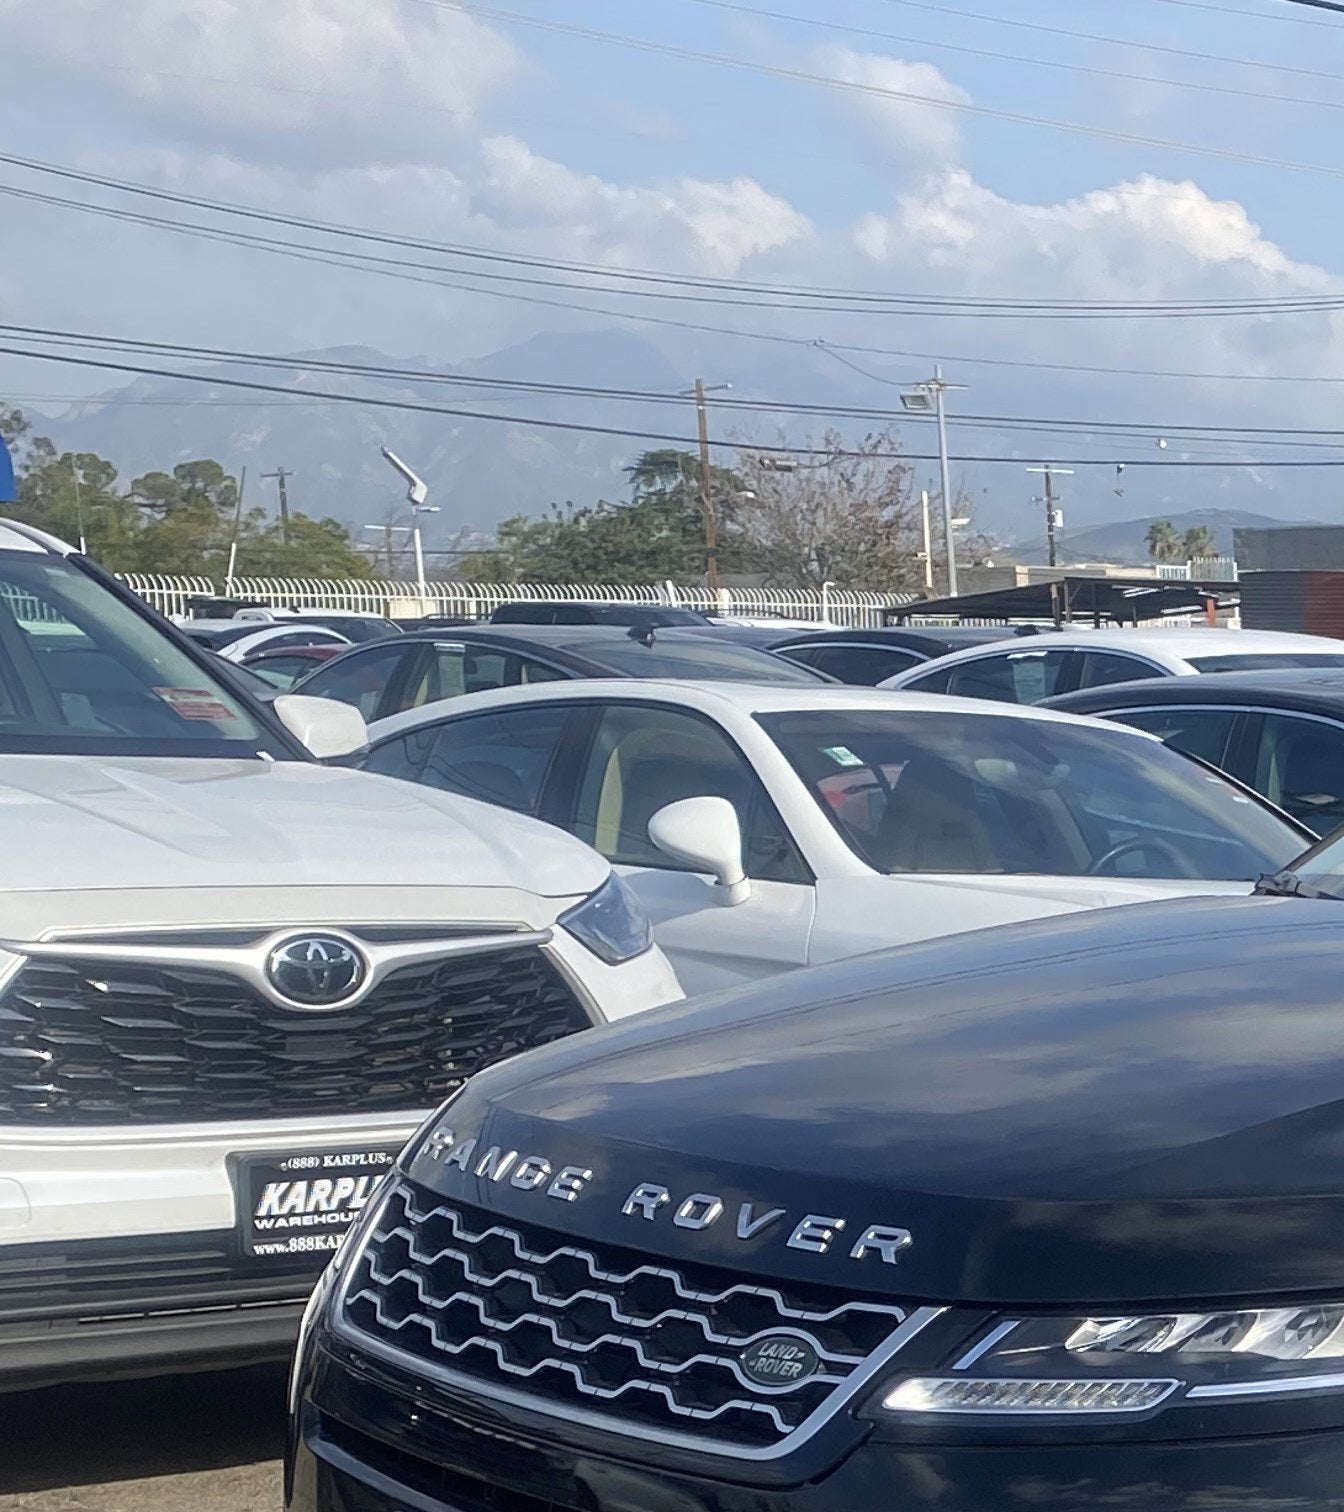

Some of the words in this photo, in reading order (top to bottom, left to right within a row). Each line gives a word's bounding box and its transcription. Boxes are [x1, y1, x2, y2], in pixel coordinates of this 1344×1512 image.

[287, 1156, 320, 1170] (888)
[322, 1151, 387, 1168] KARPLUS
[419, 1126, 594, 1201] RANGE
[621, 1181, 912, 1264] ROVER
